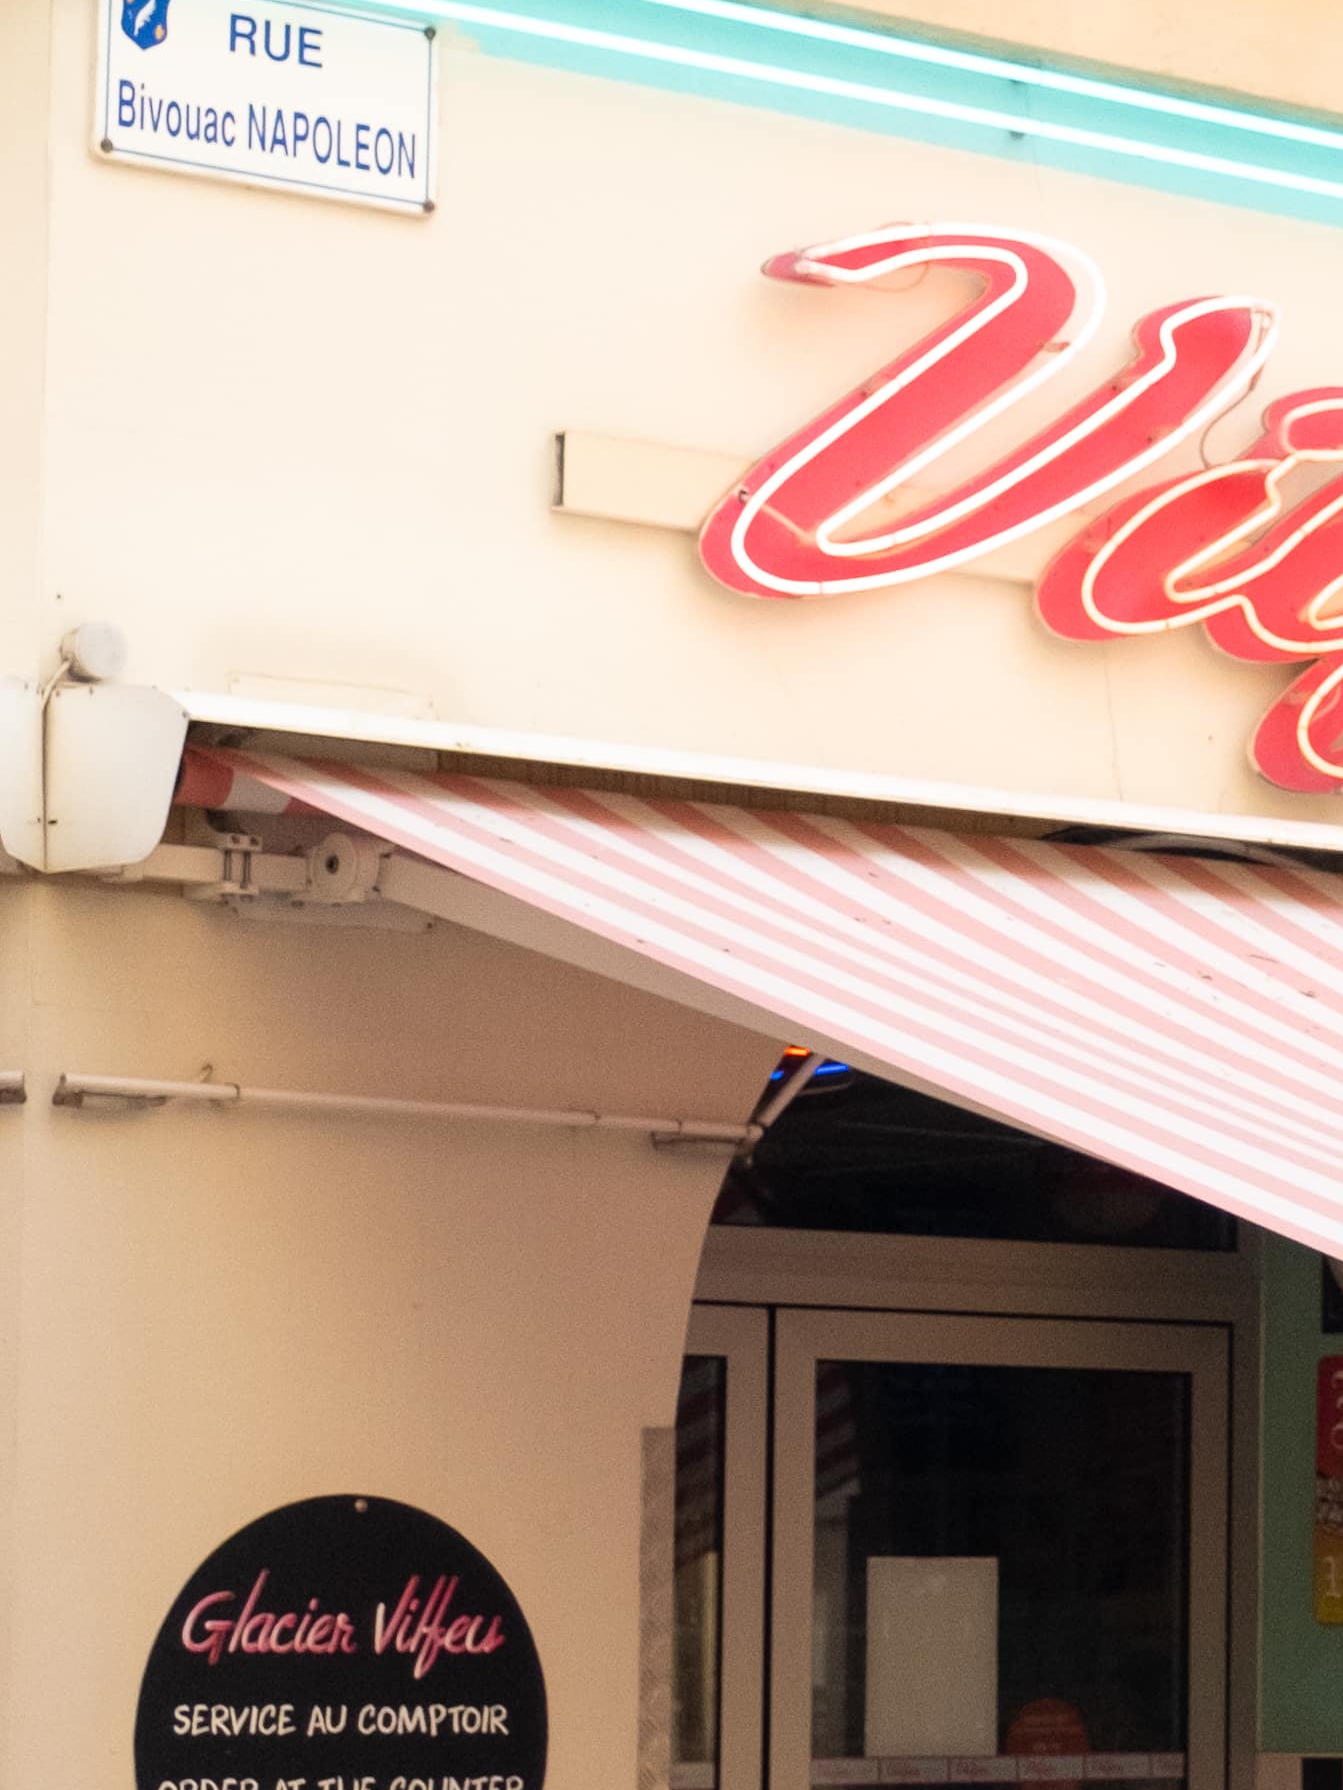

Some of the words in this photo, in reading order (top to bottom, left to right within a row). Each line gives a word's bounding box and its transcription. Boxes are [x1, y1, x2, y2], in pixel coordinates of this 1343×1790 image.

[229, 13, 323, 68] RUE
[118, 79, 236, 147] Bivouac
[249, 103, 416, 179] NAPOLEON
[181, 1567, 357, 1666] Glacier
[374, 1574, 506, 1680] Viffeu
[173, 1704, 297, 1738] SERVICE
[307, 1705, 348, 1737] AU
[357, 1703, 510, 1738] COMPTOIR
